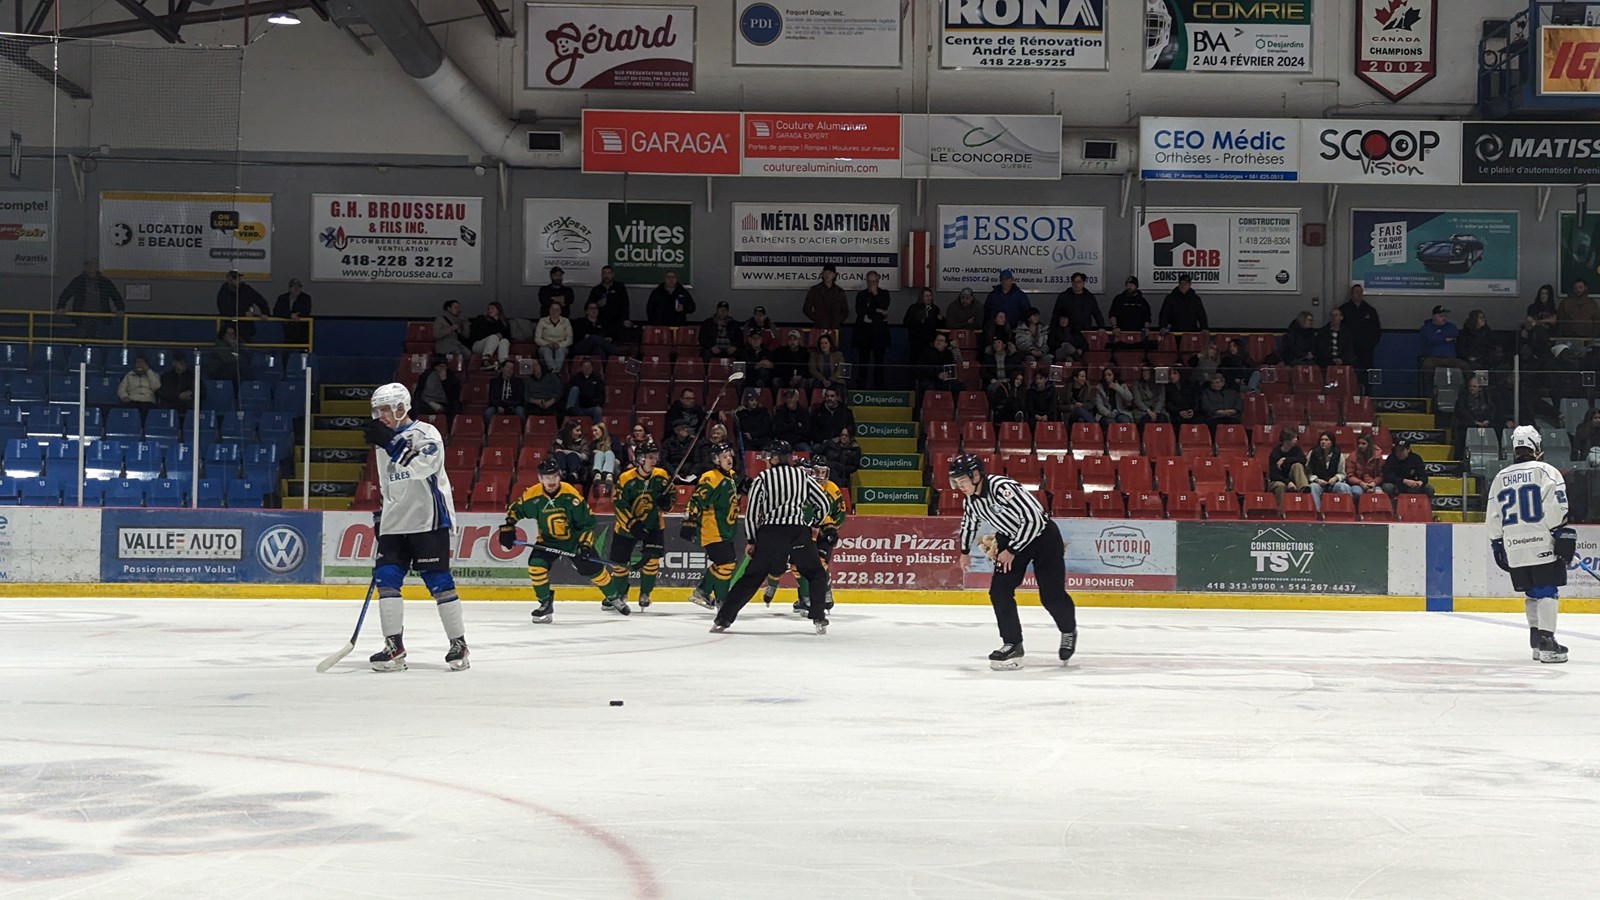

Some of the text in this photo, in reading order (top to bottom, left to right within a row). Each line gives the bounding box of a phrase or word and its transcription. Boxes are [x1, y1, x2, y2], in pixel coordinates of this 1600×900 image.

[947, 0, 1100, 26] RONA
[1193, 0, 1304, 20] COMRIE
[750, 19, 773, 29] PDI
[945, 36, 1102, 47] Centre de Rénovation
[1267, 40, 1304, 49] Desjardins
[546, 14, 676, 86] Gérard
[972, 46, 1075, 57] André Lessard
[1370, 47, 1423, 56] CHAMPIONS
[980, 58, 1067, 67] 418 228-9725
[1193, 53, 1305, 67] 2 AU 4 FÉVRIER 2024
[1549, 41, 1600, 79] IG
[1369, 61, 1423, 72] 2002
[775, 120, 868, 131] Couture Aluminium
[631, 130, 728, 154] GARAGA
[1154, 129, 1286, 150] CEO Médic
[1319, 128, 1441, 162] SCOOP
[778, 144, 799, 152] garage
[930, 153, 1033, 163] LE CONCORDE
[1155, 151, 1285, 165] Orthèses Prothèses
[1357, 149, 1425, 176] Vision
[763, 161, 878, 173] couturealuminium.com
[1478, 165, 1488, 174] Le
[1490, 165, 1516, 175] plaisir
[1517, 165, 1571, 174] d'automatiser
[330, 200, 466, 220] G.H. BROUSSEAU
[761, 210, 890, 232] MÉTAL SARTIGAN
[1238, 217, 1290, 226] CONSTRUCTION
[138, 223, 203, 235] LOCATION
[368, 221, 428, 235] & FILS INC.
[615, 220, 685, 245] vitres
[973, 215, 1077, 242] ESSOR
[1379, 225, 1402, 237] FAIS
[148, 237, 203, 248] BEAUCE
[741, 236, 890, 245] BÂTIMENTS D'ACIER OPTIMISÉS
[1245, 237, 1258, 245] 418
[1259, 237, 1290, 245] 228-8304
[1389, 235, 1402, 243] que
[972, 244, 1050, 257] ASSURANCES
[1379, 242, 1402, 251] T'AIMES
[14, 254, 48, 262] Avantis
[614, 244, 685, 262] d'autos
[1052, 245, 1099, 263] 60 ans
[1182, 249, 1221, 267] CRB
[341, 254, 454, 268] 418-228 3212
[342, 268, 453, 280] www.ghbrousseau.ca
[942, 275, 961, 283] Visitez
[962, 275, 990, 284] essor.ca
[865, 395, 903, 404] Desjardins
[869, 426, 909, 435] Desjardins
[872, 458, 912, 467] Desjardins
[1502, 471, 1533, 487] CHAPUT
[877, 491, 919, 500] Desjardins
[1496, 483, 1545, 526] 20
[190, 533, 237, 549] AUTO
[893, 533, 956, 550] Pizza
[1250, 541, 1314, 551] CONSTRUCTIONS
[1512, 536, 1544, 546] Desjardins
[1095, 539, 1151, 555] VICTORIA
[833, 553, 867, 563] aime
[870, 552, 903, 563] faire
[1250, 551, 1315, 573] TSV
[123, 565, 236, 573] Passionnément Volks!
[671, 572, 685, 580] 418
[1068, 578, 1134, 587] DU BONHEUR
[1230, 582, 1276, 590] 313-9900
[1311, 584, 1356, 592] 267-4437
